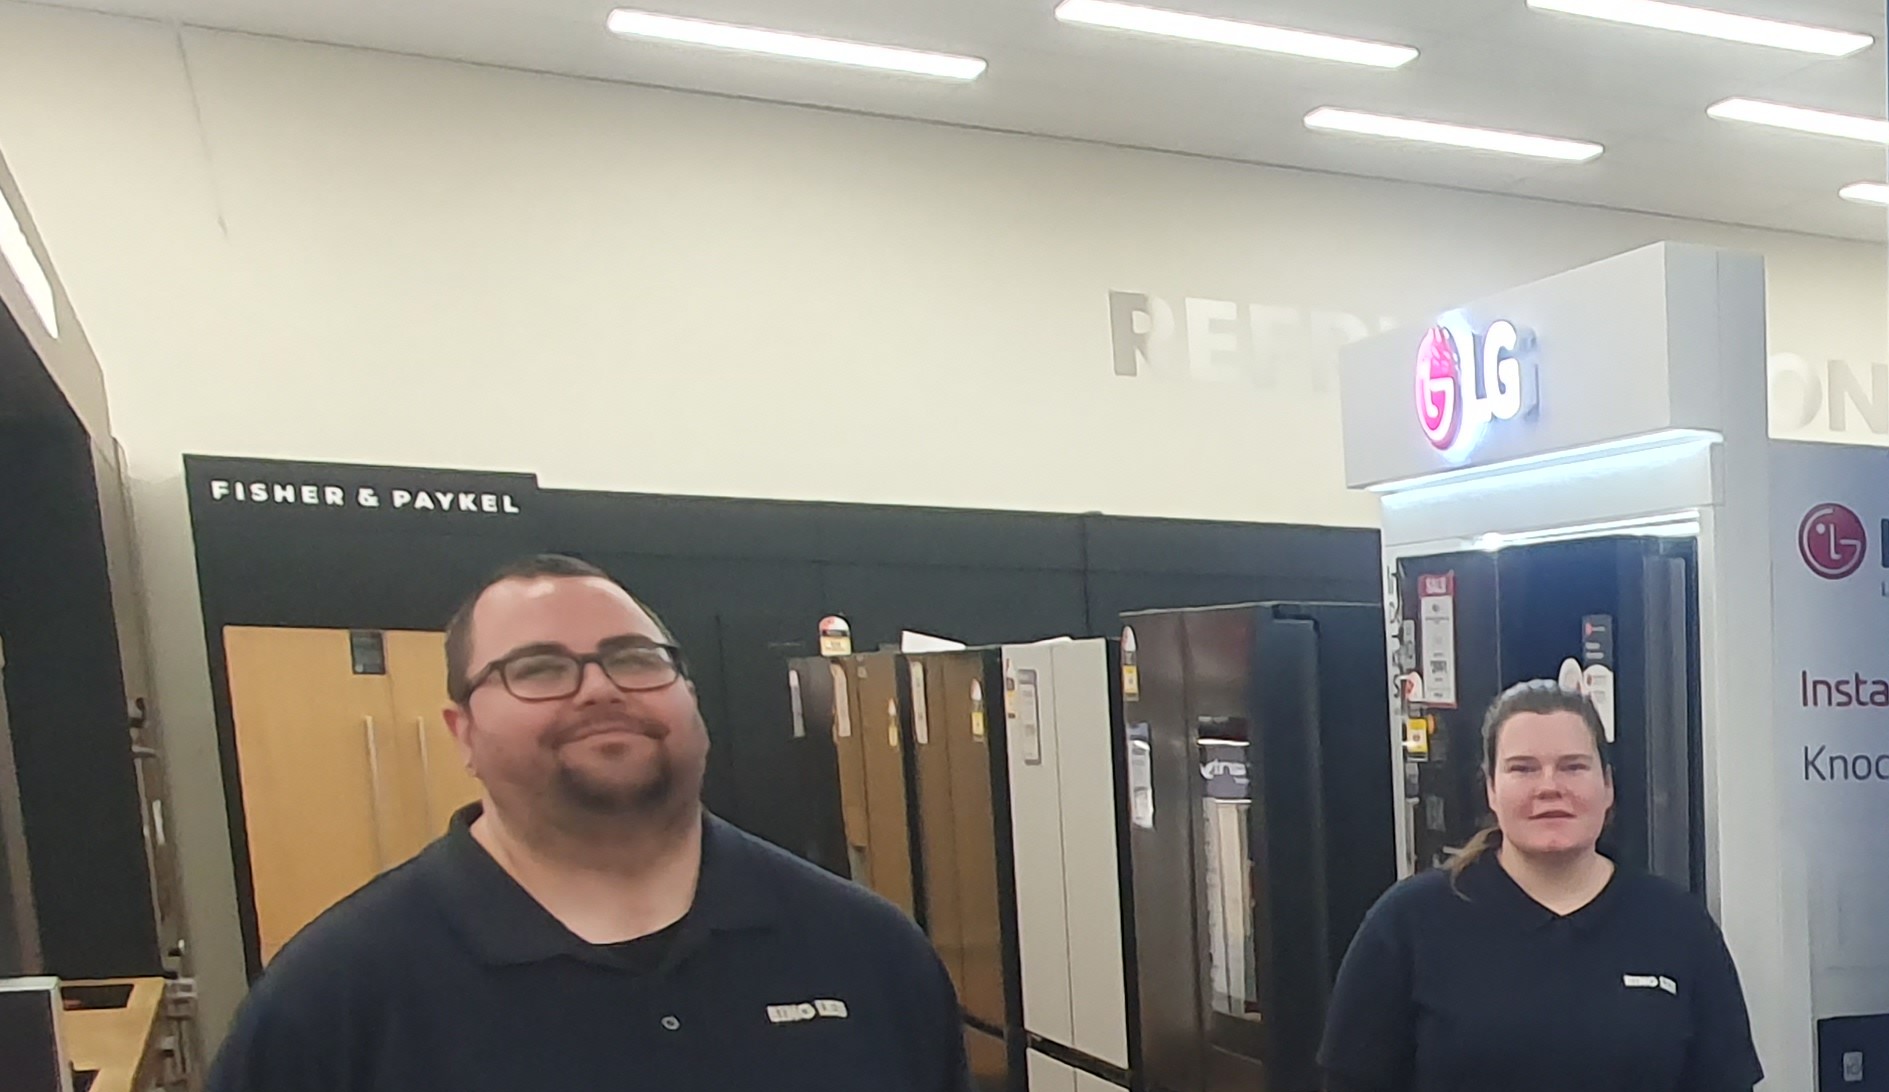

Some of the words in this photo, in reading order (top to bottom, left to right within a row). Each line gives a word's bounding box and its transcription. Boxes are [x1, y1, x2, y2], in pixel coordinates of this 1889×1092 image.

[1459, 318, 1523, 422] LG
[210, 479, 345, 507] FISHER
[357, 487, 380, 507] &
[391, 489, 520, 514] PAYKEL
